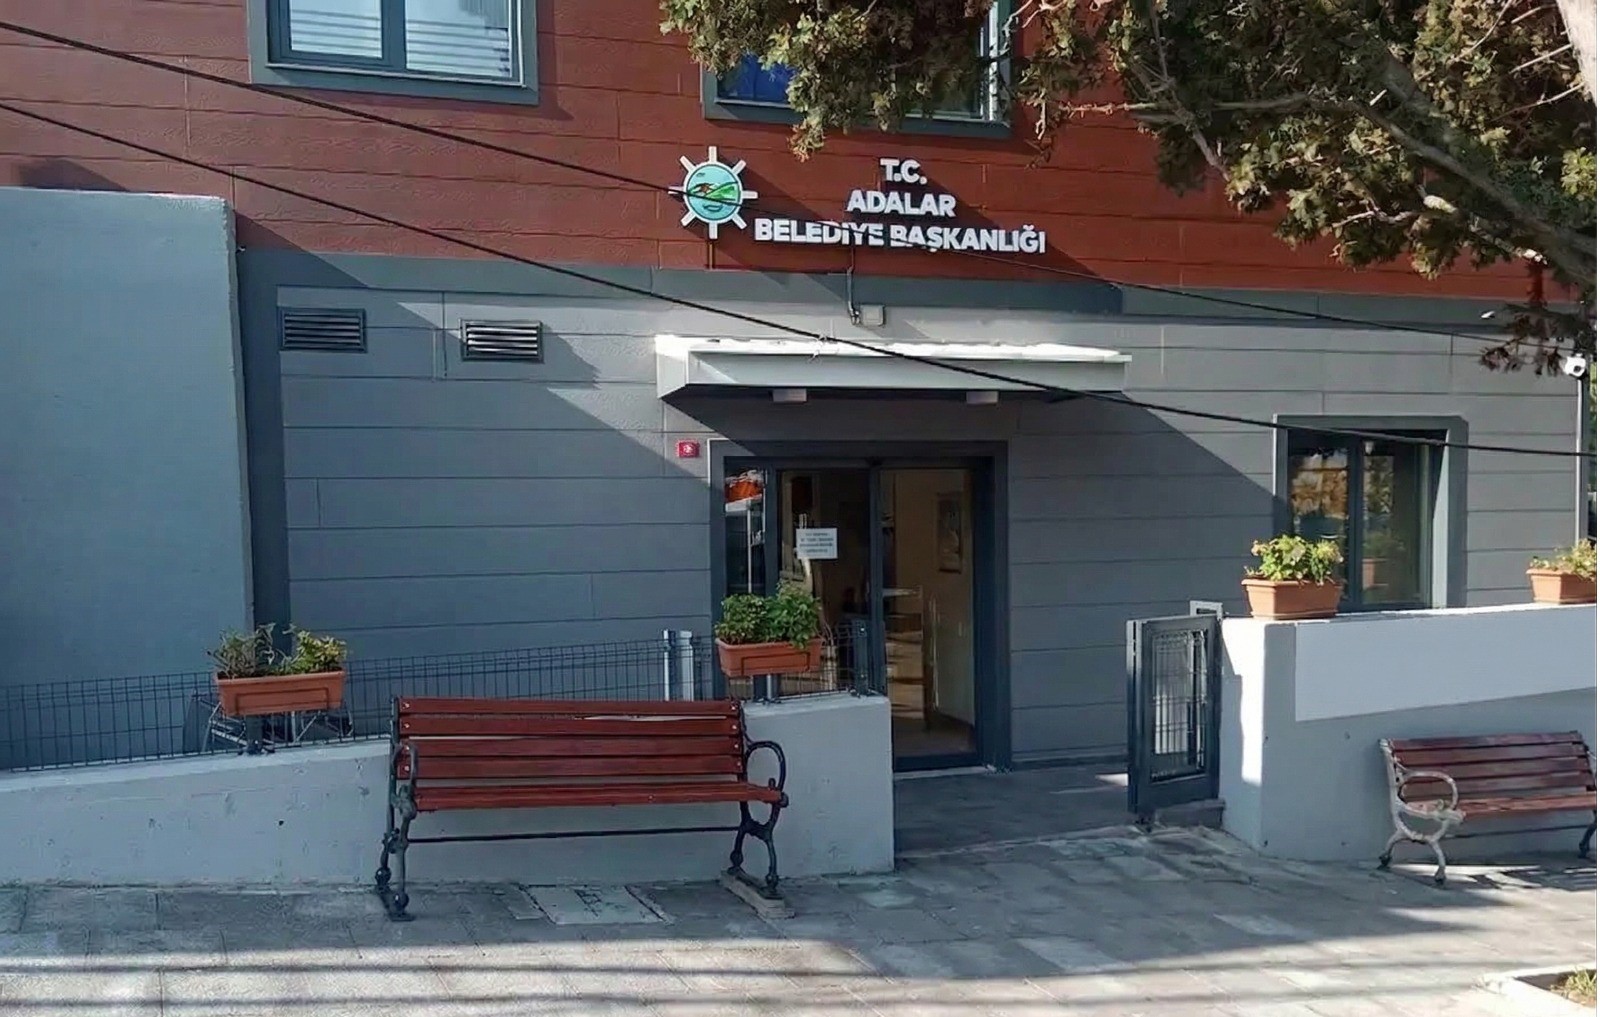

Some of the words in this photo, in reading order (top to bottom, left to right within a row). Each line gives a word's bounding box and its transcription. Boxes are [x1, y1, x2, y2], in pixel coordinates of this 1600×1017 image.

[880, 158, 927, 185] T.C.
[846, 190, 956, 218] ADALAR
[889, 224, 1047, 254] BAŞKANLIĞI
